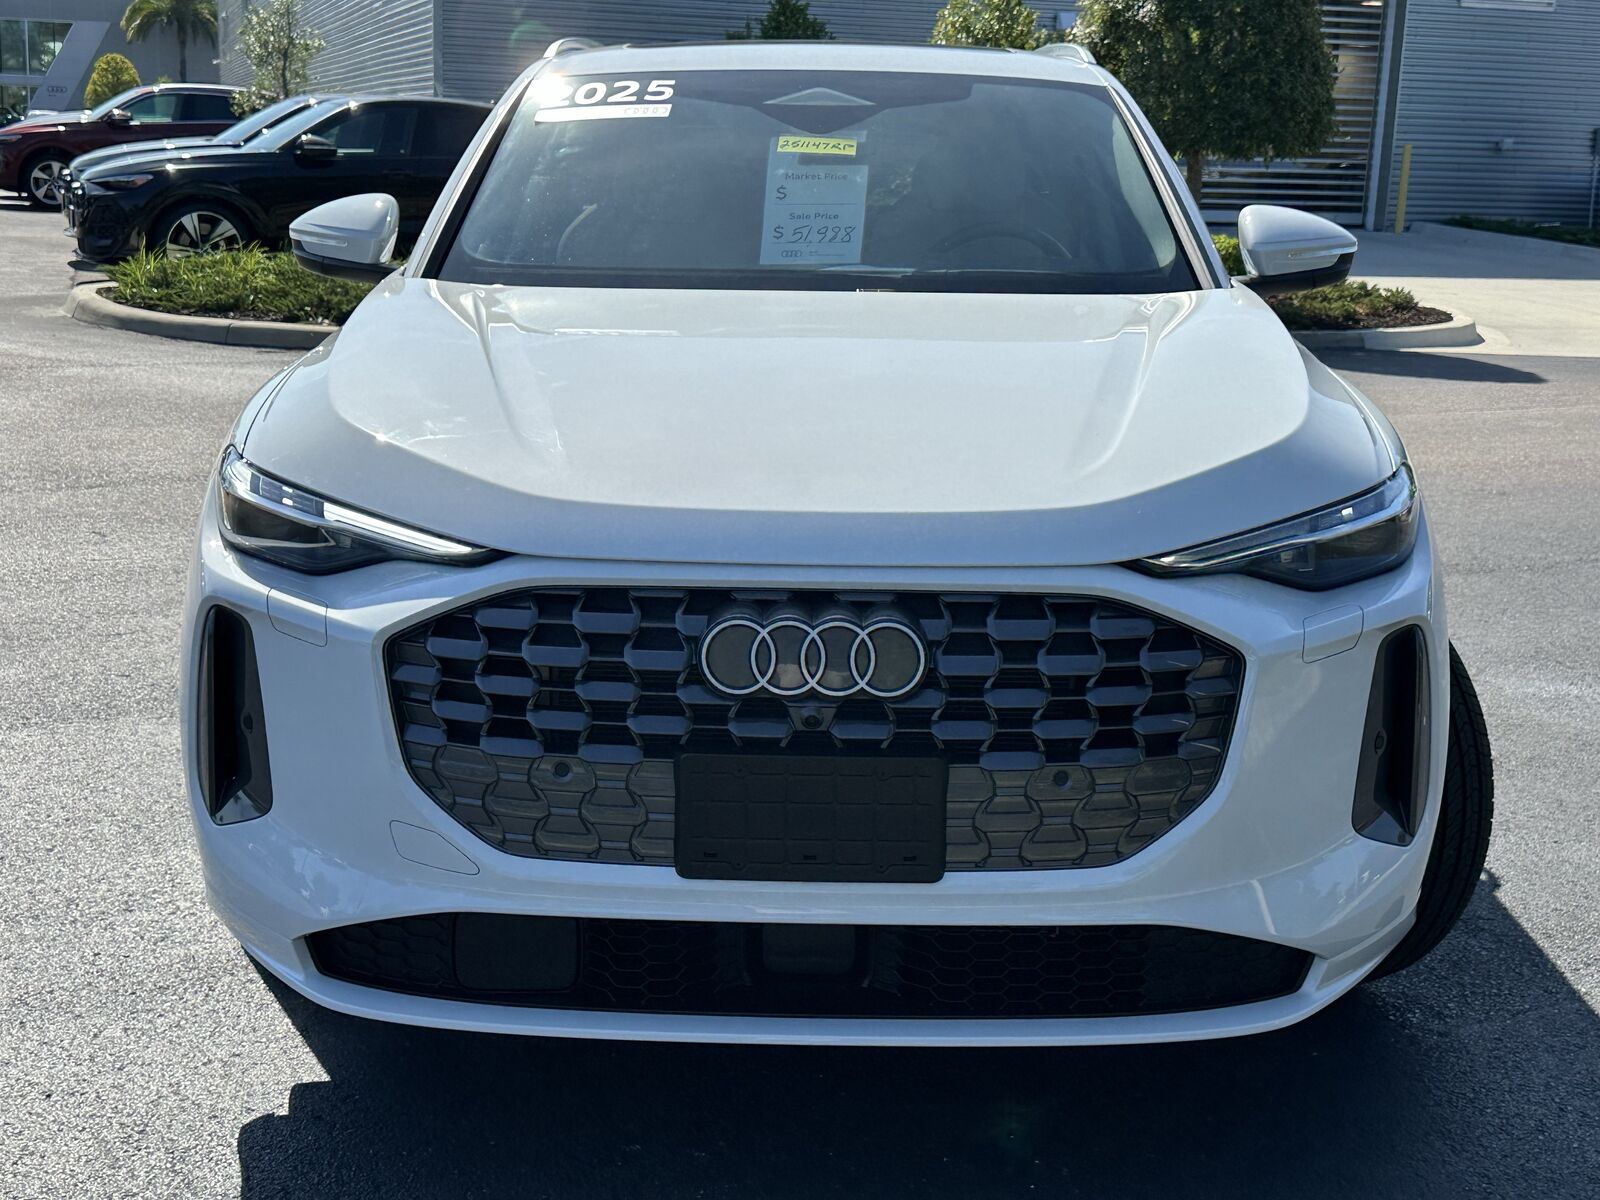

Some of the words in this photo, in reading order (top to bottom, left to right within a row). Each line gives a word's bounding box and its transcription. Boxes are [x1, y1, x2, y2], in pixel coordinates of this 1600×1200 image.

[540, 80, 676, 108] 2025
[785, 172, 822, 180] Market
[776, 184, 788, 200] $
[789, 212, 811, 220] Sale
[815, 212, 839, 220] Price
[773, 225, 784, 240] $
